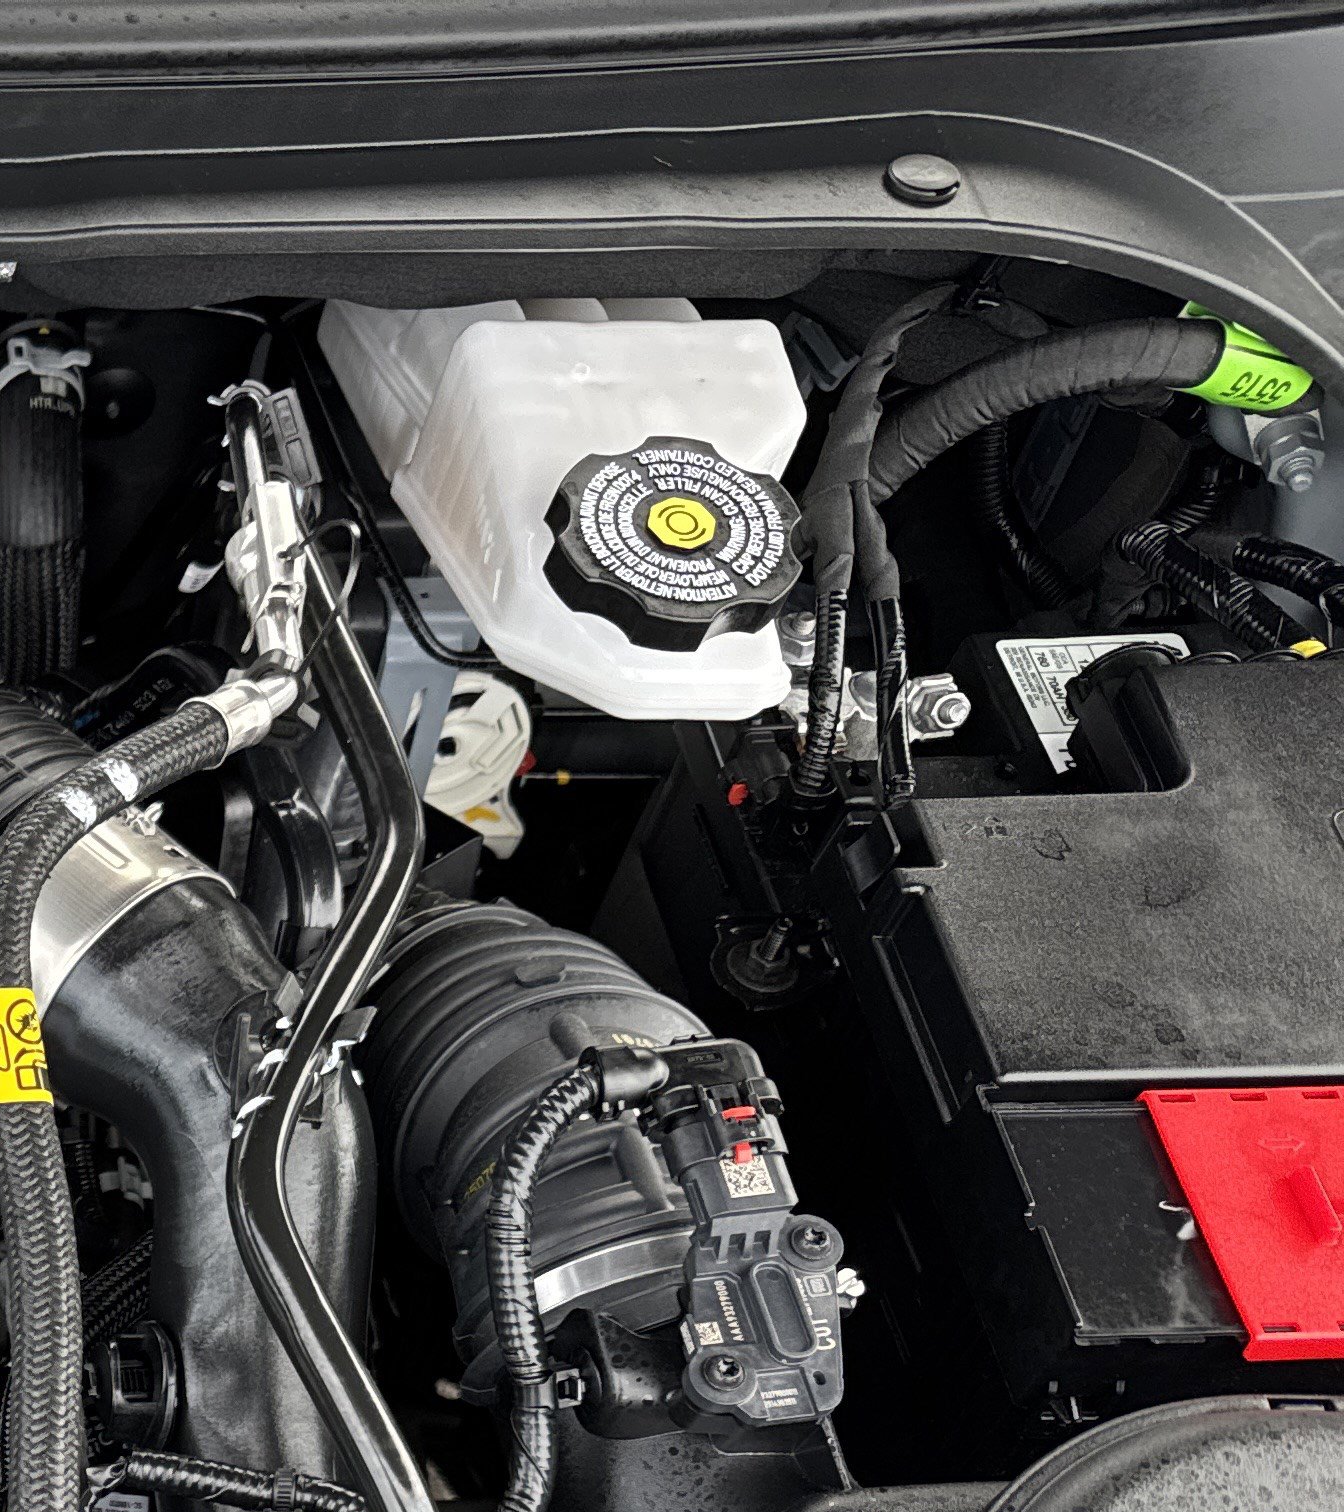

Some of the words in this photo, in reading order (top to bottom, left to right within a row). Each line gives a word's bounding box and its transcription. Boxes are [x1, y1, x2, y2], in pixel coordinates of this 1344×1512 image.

[648, 463, 681, 477] ONLY
[683, 465, 709, 481] USE
[715, 462, 761, 494] SEALED
[654, 477, 701, 493] FILLER
[701, 485, 738, 515] CLEAN
[754, 491, 769, 500] A
[759, 500, 783, 530] FROM
[746, 517, 765, 556] BEFORE
[764, 532, 784, 562] FLUID
[601, 555, 621, 570] LE
[620, 552, 640, 567] DU
[732, 553, 755, 574] CAP
[634, 561, 659, 578] QUE
[745, 563, 771, 586] DOT
